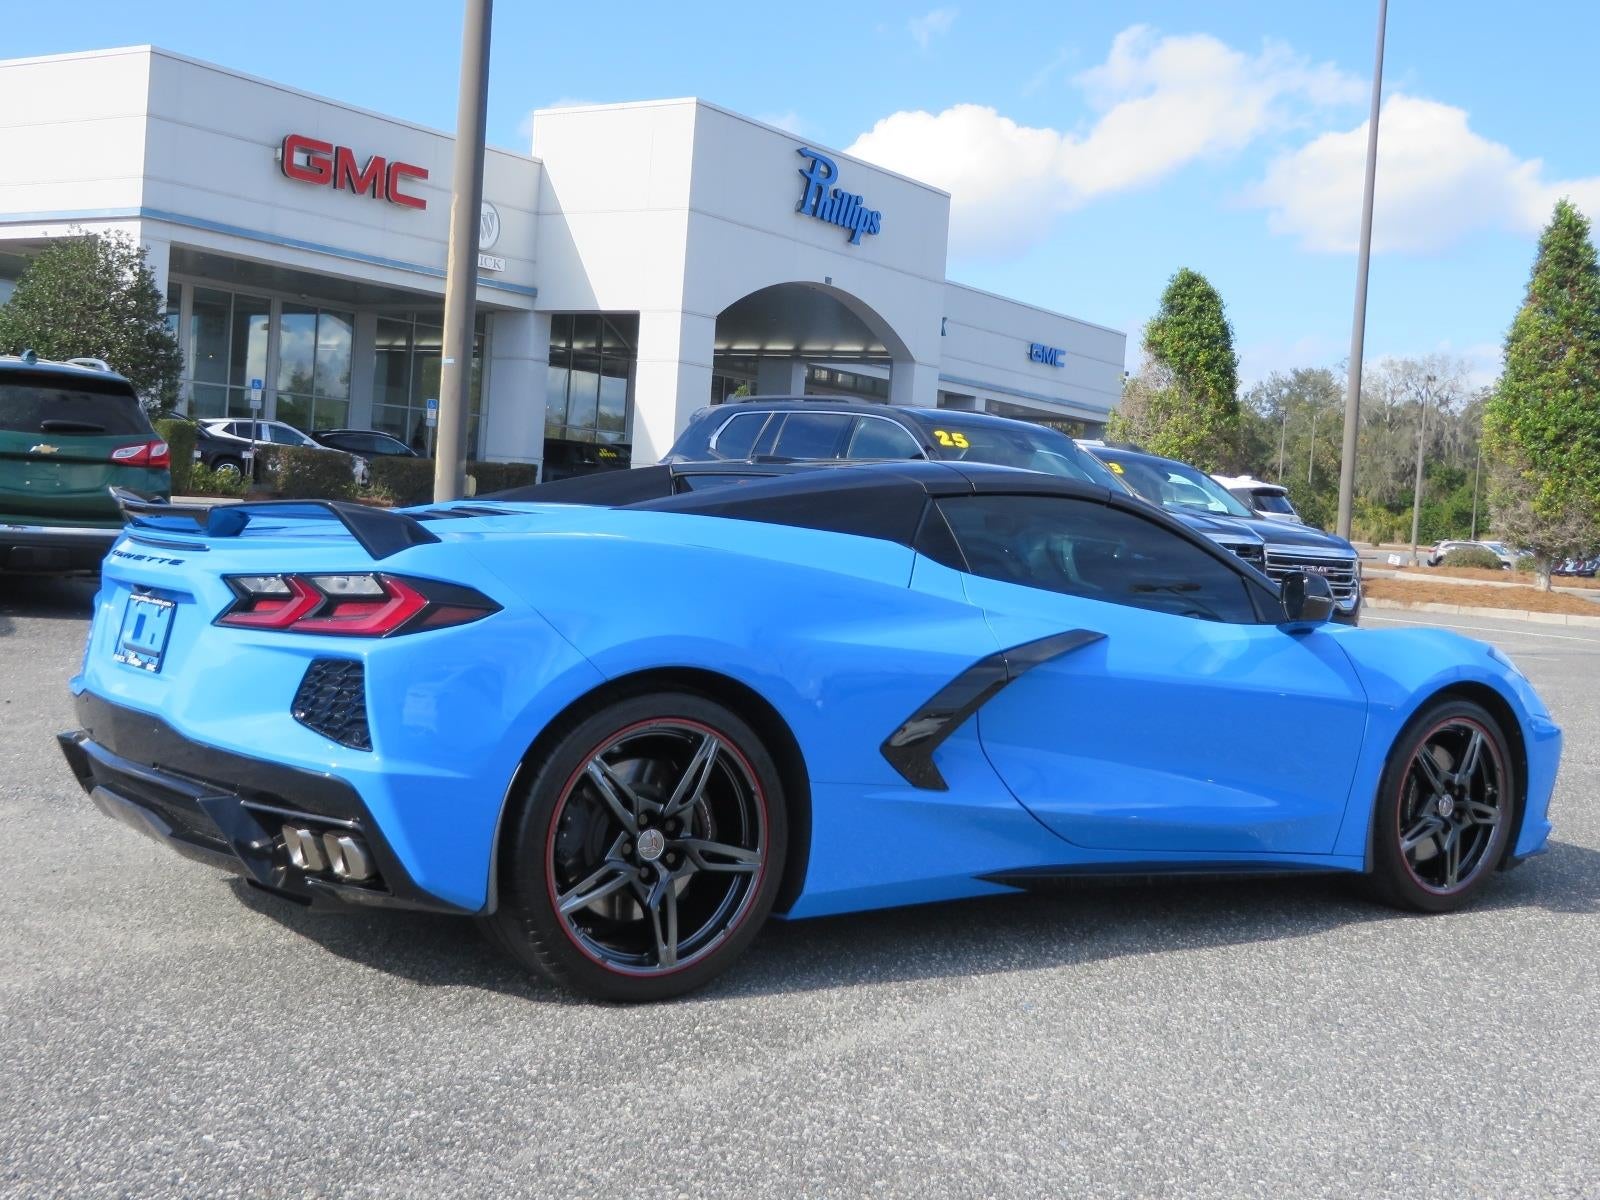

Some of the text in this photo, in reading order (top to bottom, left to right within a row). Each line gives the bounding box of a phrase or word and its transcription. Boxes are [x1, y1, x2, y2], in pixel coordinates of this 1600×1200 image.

[281, 134, 429, 210] GMC
[796, 147, 882, 246] Phillips
[480, 256, 502, 269] ICK
[1029, 342, 1066, 367] GMC
[934, 430, 970, 449] 25
